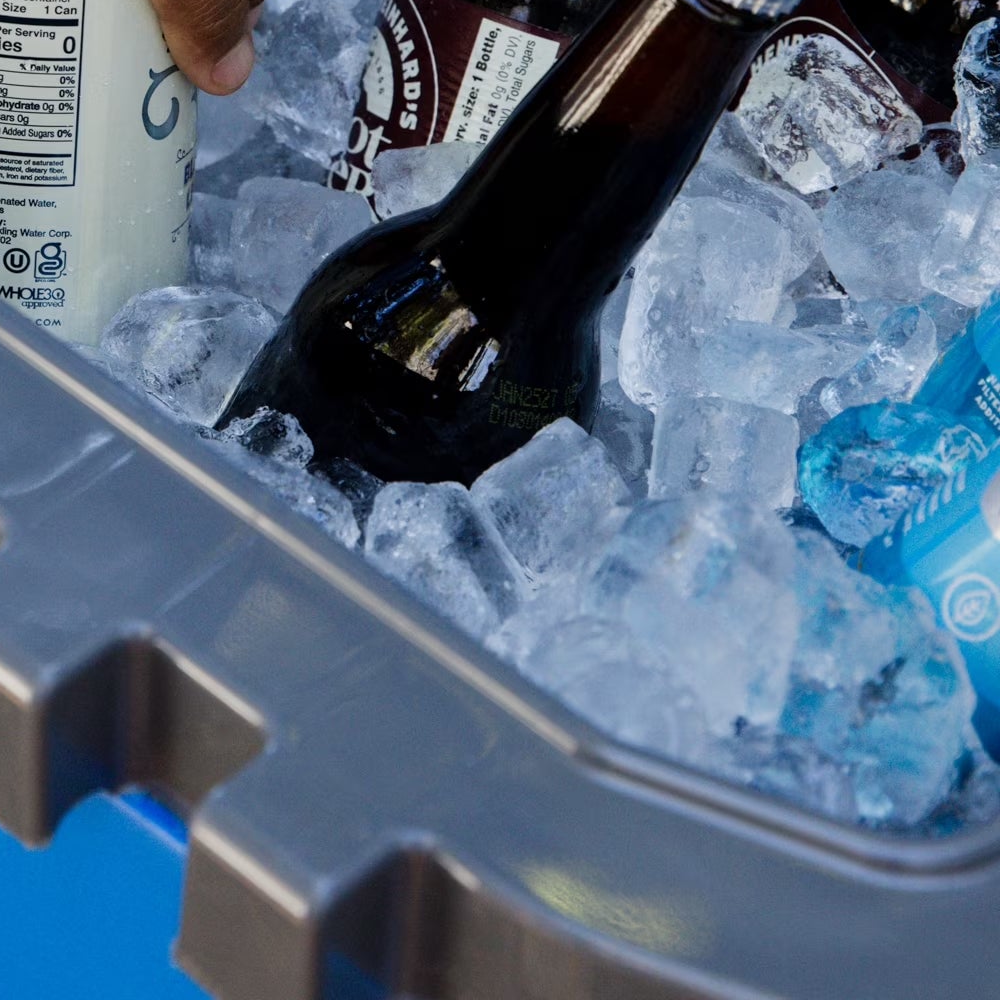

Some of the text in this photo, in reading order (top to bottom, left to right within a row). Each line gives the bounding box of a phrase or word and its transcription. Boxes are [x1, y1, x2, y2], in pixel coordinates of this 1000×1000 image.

[2, 2, 26, 13] Size
[45, 5, 50, 14] 1
[54, 5, 77, 15] Can
[15, 27, 56, 40] Serving
[62, 36, 76, 54] 0
[504, 34, 523, 57] DV).
[30, 64, 50, 73] Daily
[53, 64, 76, 72] Value
[498, 61, 513, 83] (0%
[505, 70, 523, 104] Total
[516, 39, 536, 76] Sugars
[59, 76, 76, 85] 0%
[454, 26, 502, 142] rv. size: 1 Bottle,
[58, 89, 75, 98] 0%
[491, 84, 506, 100] 0g
[42, 103, 54, 113] 0g
[58, 102, 74, 111] 0%
[482, 102, 499, 125] Fat
[17, 114, 29, 125] 0g
[2, 126, 26, 137] Added
[28, 128, 54, 139] Sugars
[56, 129, 73, 138] 0%
[25, 166, 47, 175] dietary
[28, 199, 57, 208] Water,
[20, 228, 46, 237] Water
[49, 229, 72, 239] Corp.
[21, 300, 64, 309] approved
